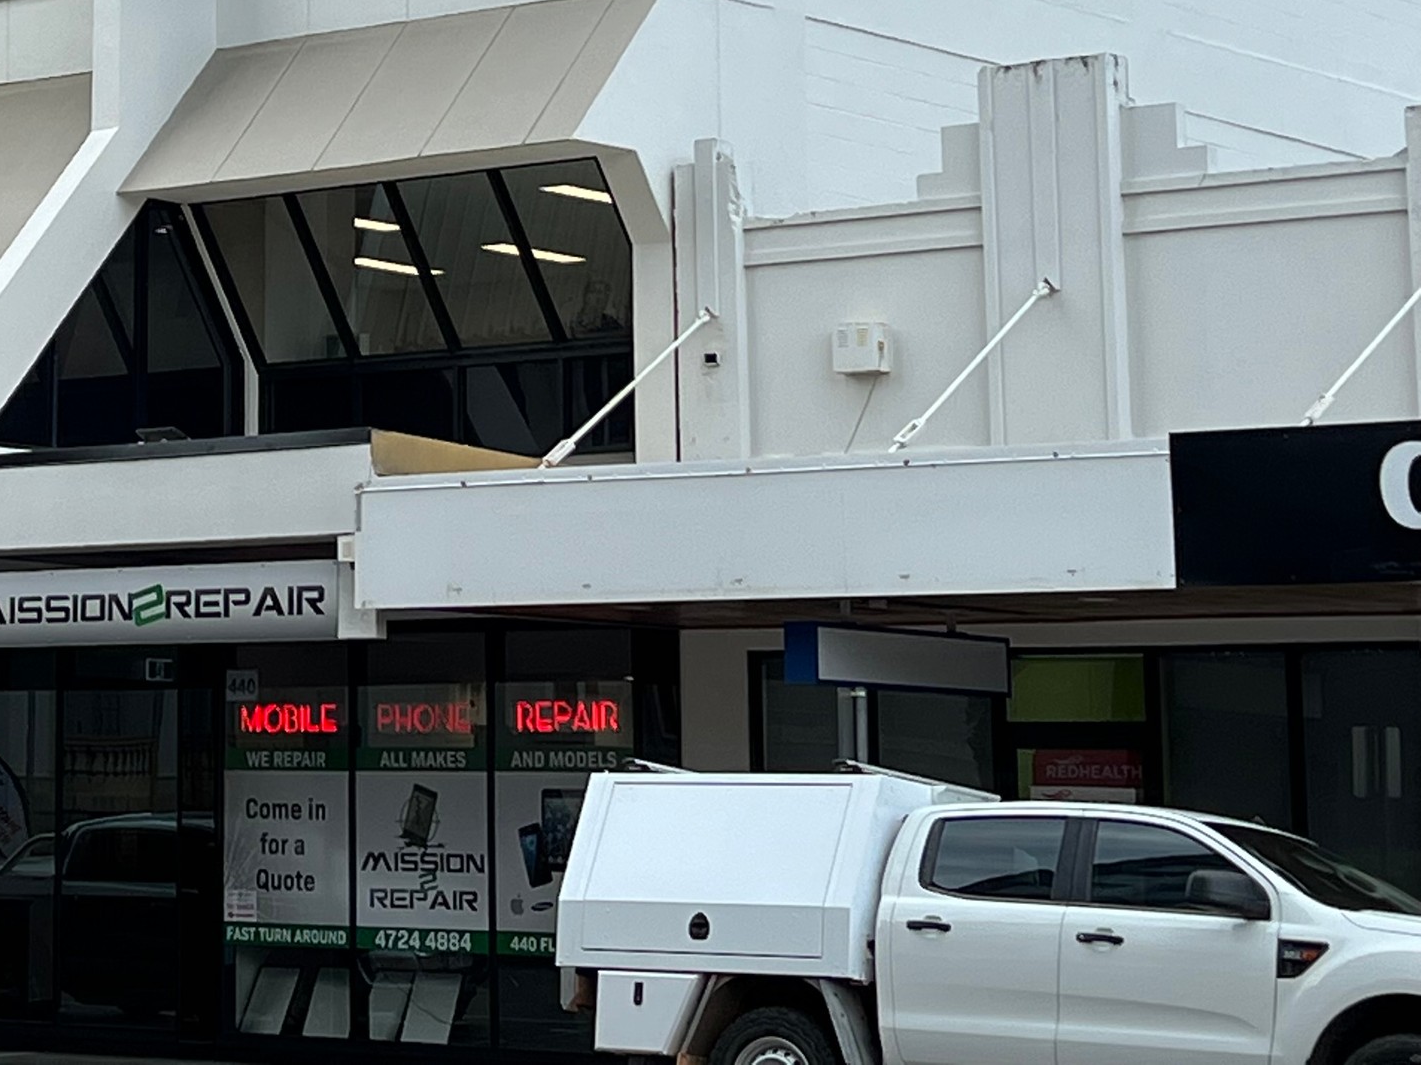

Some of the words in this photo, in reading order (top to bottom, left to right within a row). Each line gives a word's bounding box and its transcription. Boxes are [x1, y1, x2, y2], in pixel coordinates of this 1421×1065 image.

[227, 677, 256, 695] 440
[239, 702, 339, 734] MOBILE
[376, 701, 473, 734] PHONE
[515, 699, 619, 734] REPAIR
[245, 750, 271, 768] WE
[273, 750, 326, 768] REPAIR
[379, 750, 408, 768] ALL
[411, 750, 467, 768] MAKES
[510, 750, 545, 769] AND
[548, 750, 617, 768] MODELS
[1045, 764, 1143, 779] REDHEALTH
[246, 797, 303, 820] Come
[308, 797, 326, 821] in
[260, 832, 289, 855] for
[294, 839, 305, 855] a
[360, 851, 485, 874] MISSION
[256, 868, 316, 892] Quote
[369, 888, 478, 912] REPAIR
[225, 925, 256, 941] FAST
[257, 926, 291, 943] TURN
[293, 928, 347, 945] AROUND
[374, 929, 421, 949] 4724
[424, 931, 472, 952] 4884
[509, 935, 538, 952] 440
[540, 936, 555, 953] FL
